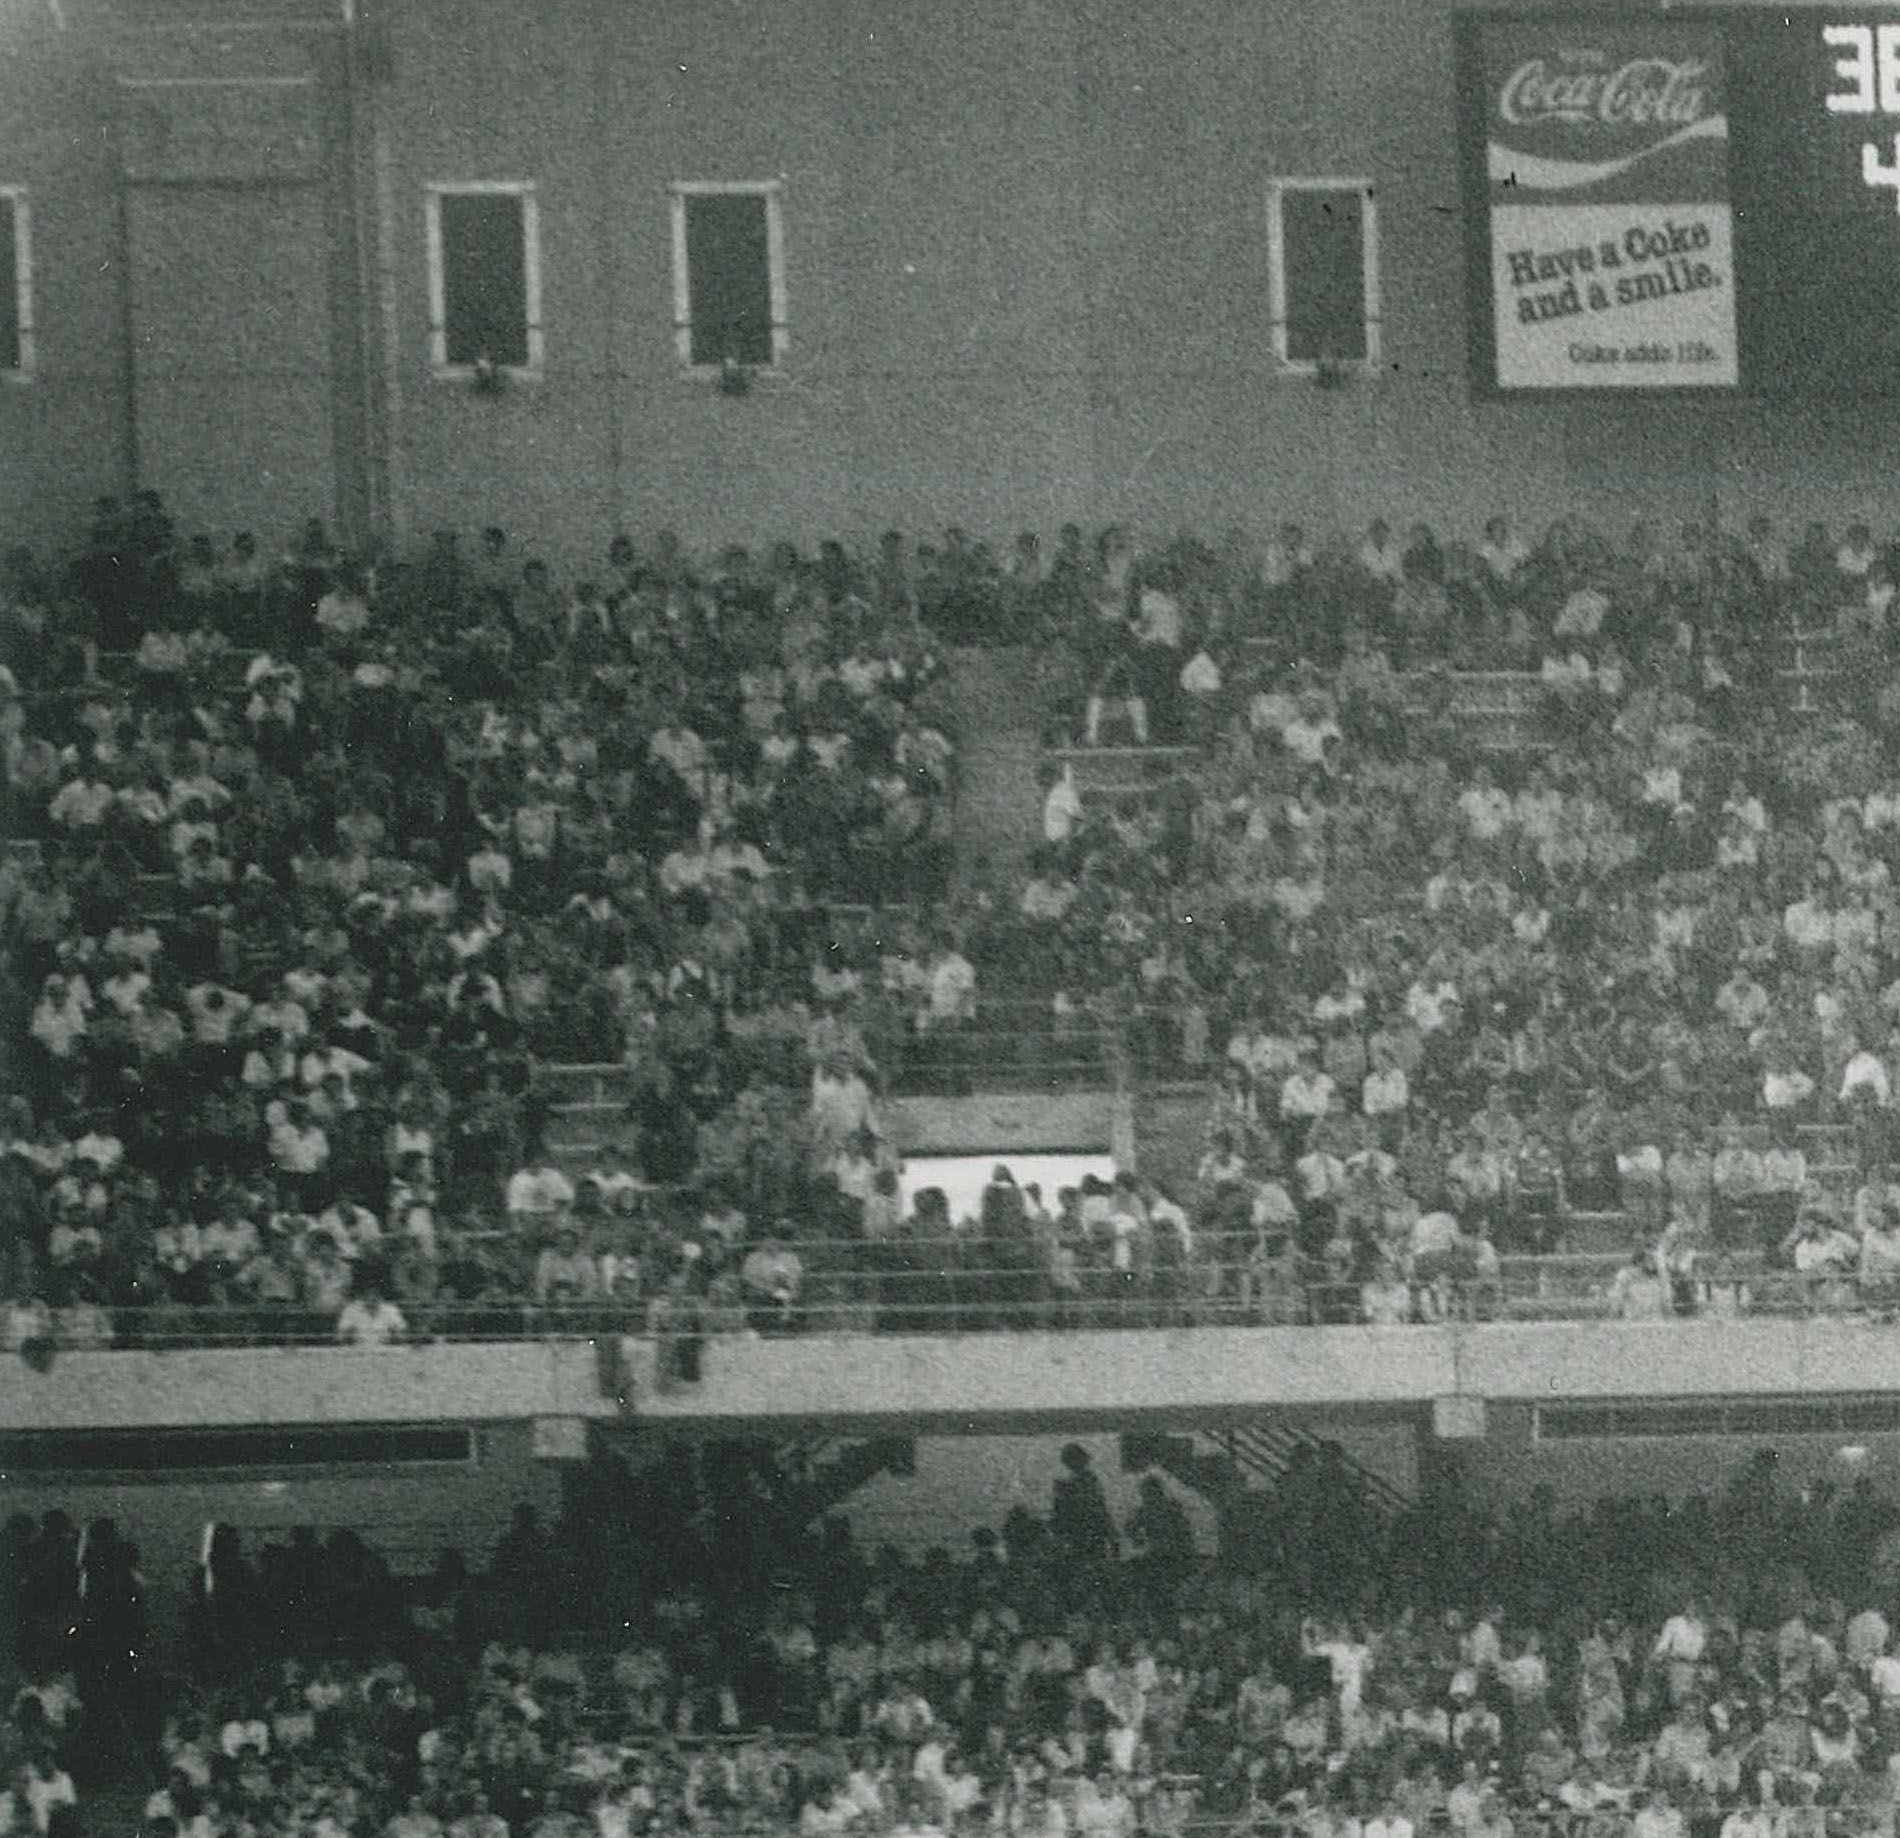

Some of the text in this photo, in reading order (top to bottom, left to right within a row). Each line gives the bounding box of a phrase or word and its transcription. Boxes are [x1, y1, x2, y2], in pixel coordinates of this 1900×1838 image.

[1507, 221, 1712, 287] Have a Coke
[1516, 281, 1583, 325] and
[1588, 282, 1611, 312] a
